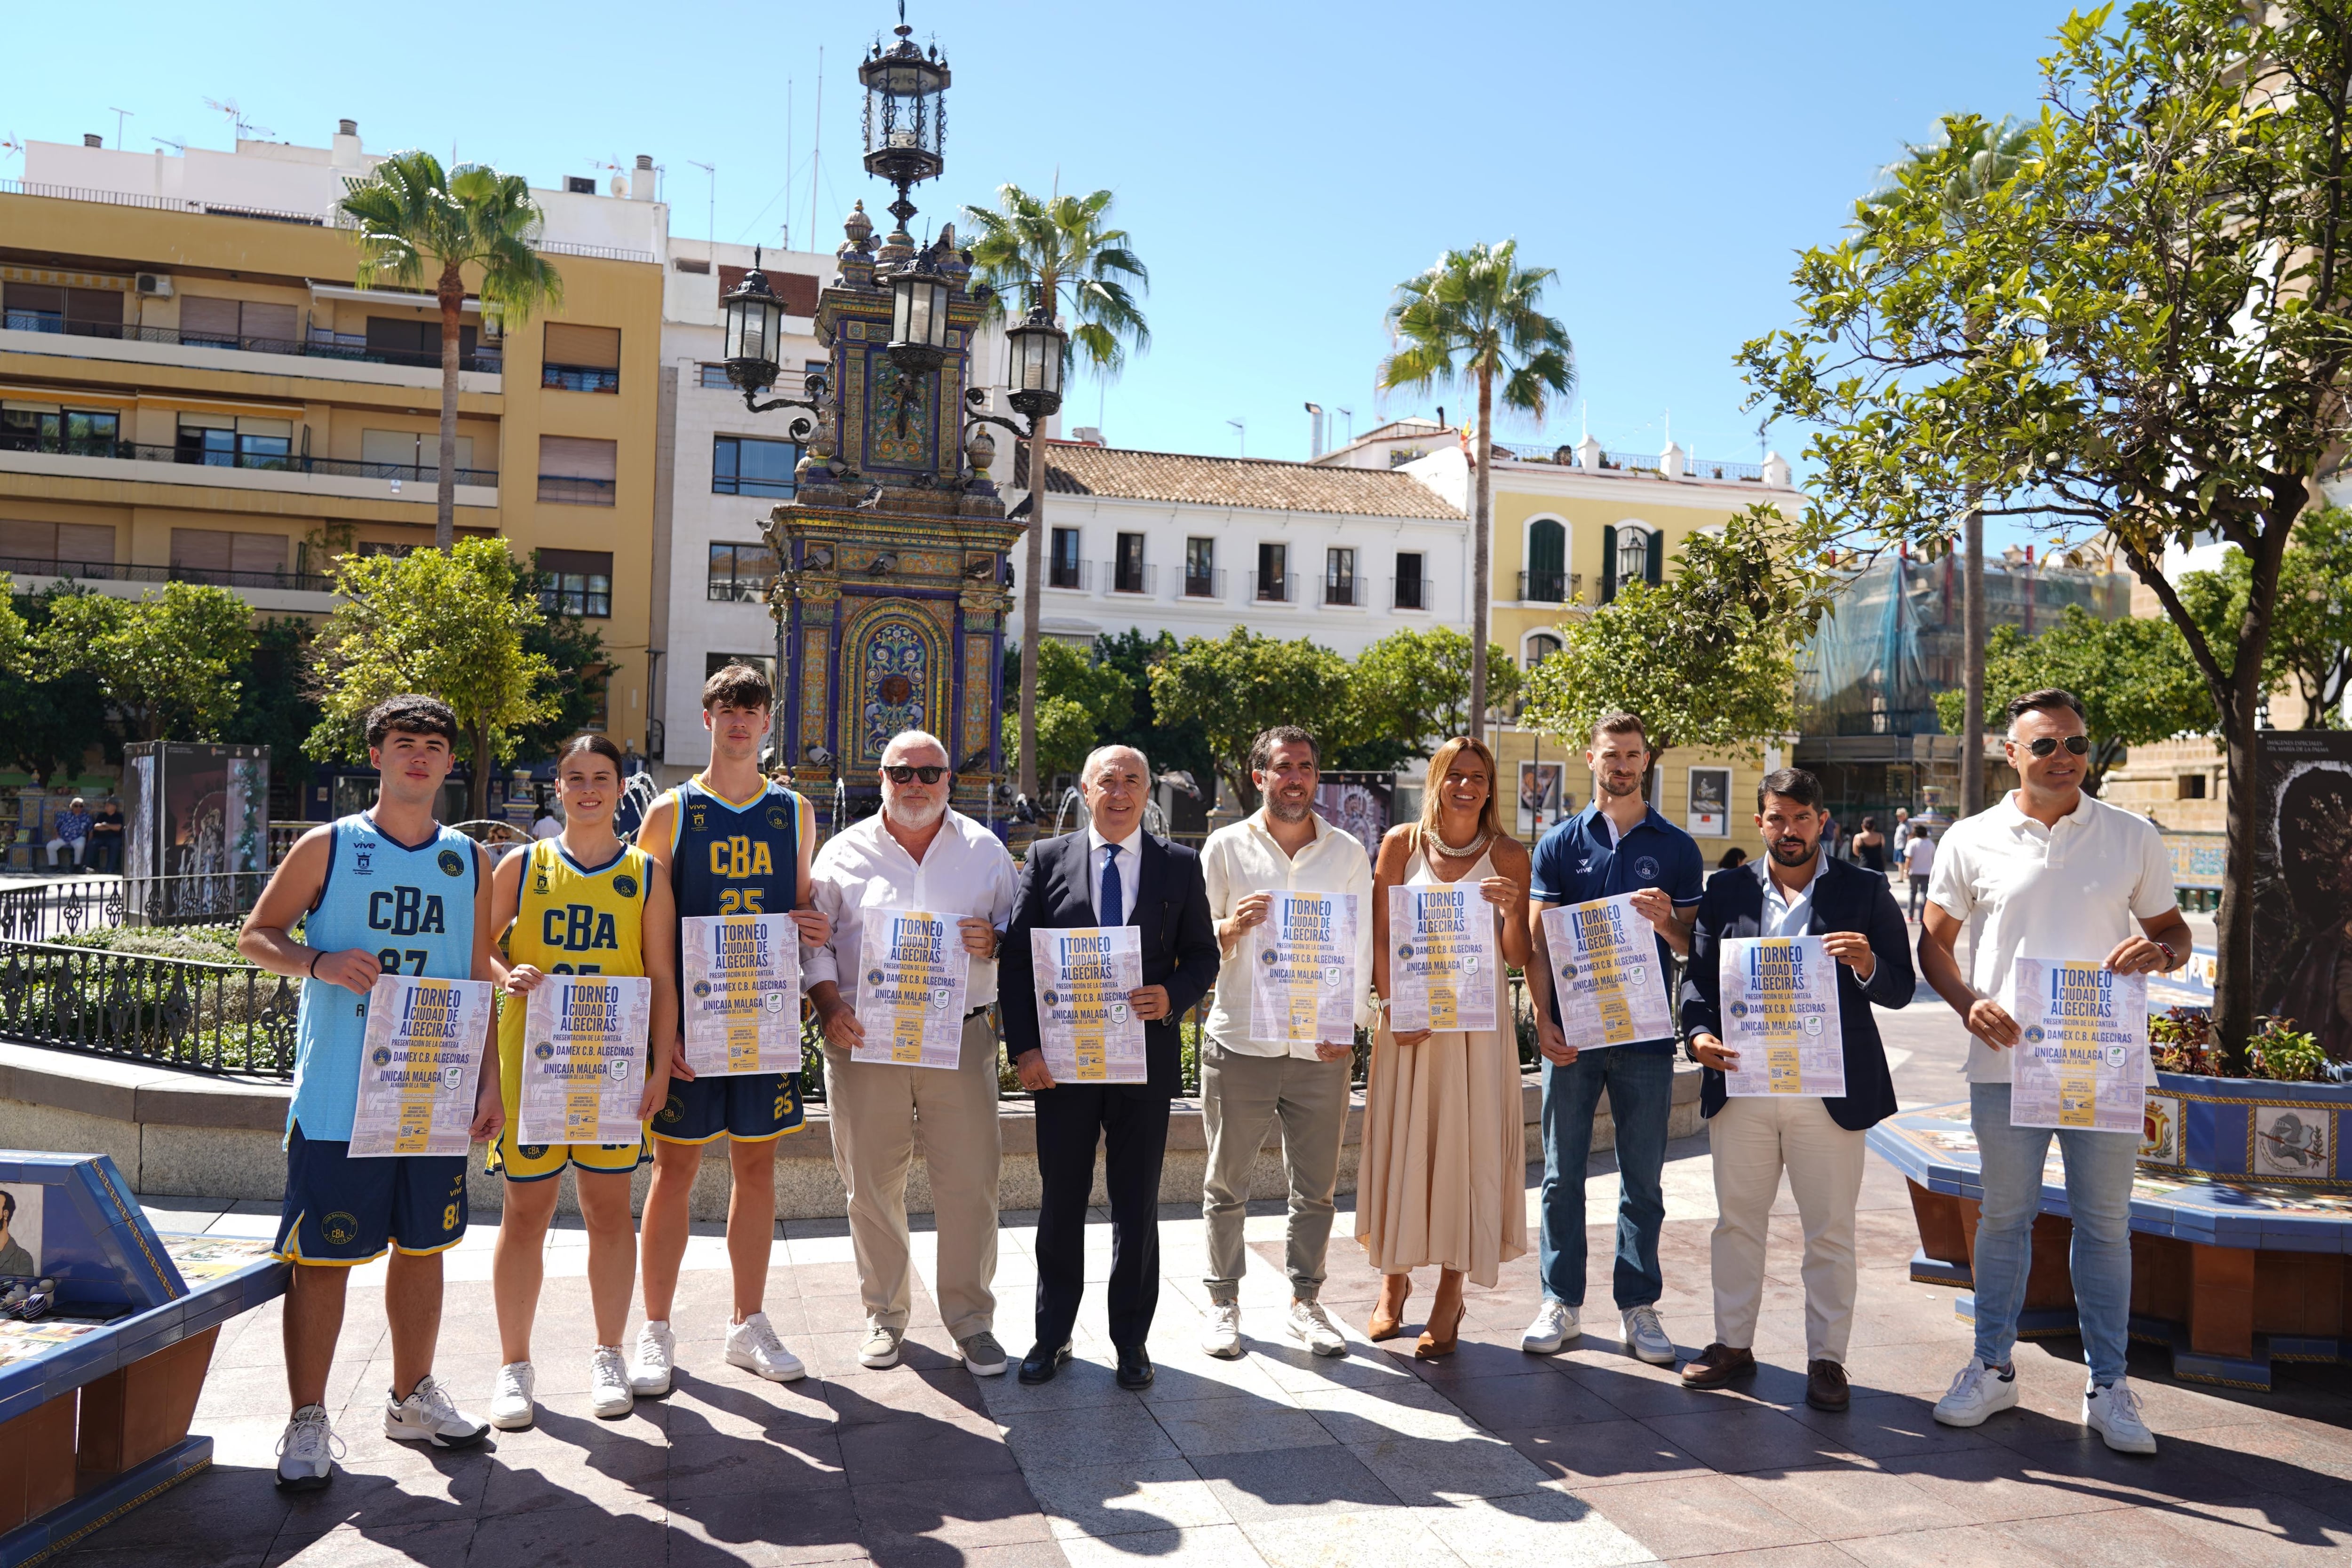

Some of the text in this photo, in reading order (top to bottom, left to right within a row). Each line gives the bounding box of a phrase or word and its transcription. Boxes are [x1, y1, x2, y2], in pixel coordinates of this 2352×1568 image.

[709, 835, 773, 879] CBA
[719, 888, 764, 915] 25
[1418, 891, 1464, 920] I TORNEO
[368, 886, 445, 935] CBA
[1284, 899, 1331, 926] I TORNEO
[1424, 908, 1464, 920] CIUDAD DE
[543, 904, 618, 951] CBA
[1290, 916, 1330, 928] CIUDAD DE
[1418, 919, 1464, 934] ALGECIRAS
[1572, 904, 1621, 939] I TORNEO
[892, 919, 943, 946] I TORNEO
[1283, 927, 1329, 942] ALGECIRAS
[1581, 920, 1623, 938] CIUDAD DE
[715, 923, 767, 954] I TORNEO
[898, 936, 942, 950] CIUDAD DE
[1578, 931, 1626, 952] ALGECIRAS
[723, 941, 767, 954] CIUDAD DE
[1060, 936, 1111, 966] I TORNEO
[1416, 946, 1435, 955] DAMEX
[1451, 944, 1482, 953] ALGECIRAS
[377, 948, 428, 976] 87
[715, 953, 768, 969] ALGECIRAS
[890, 947, 940, 963] ALGECIRAS
[1067, 953, 1111, 966] CIUDAD DE
[1280, 953, 1344, 965] DAMEX C.B. ALGECIRAS
[1751, 946, 1803, 975] I TORNEO
[1407, 962, 1432, 971] UNICAJA
[1579, 953, 1647, 973] DAMEX C.B. ALGECIRAS
[1757, 964, 1803, 976] CIUDAD DE
[1062, 966, 1112, 980] ALGECIRAS
[1270, 969, 1295, 979] UNICAJA
[714, 980, 787, 992] DAMEX C.B. ALGECIRAS
[887, 974, 955, 987] DAMEX C.B. ALGECIRAS
[1573, 978, 1599, 990] UNICAJA
[1751, 976, 1804, 990] ALGECIRAS
[2052, 969, 2112, 999] I TORNEO
[563, 985, 619, 1015] I TORNEO
[875, 989, 902, 1000] UNICAJA
[1061, 994, 1081, 1002] DAMEX
[1097, 991, 1131, 1002] ALGECIRAS
[2060, 988, 2112, 1002] CIUDAD DE
[403, 987, 461, 1019] I TORNEO
[704, 997, 763, 1010] UNICAJA MÁLAGA
[1750, 1004, 1826, 1013] DAMEX C.B. ALGECIRAS
[2051, 1001, 2111, 1017] ALGECIRAS
[410, 1007, 459, 1022] CIUDAD DE
[569, 1004, 617, 1017] CIUDAD DE
[1052, 1008, 1108, 1019] UNICAJA MÁLAGA
[399, 1021, 456, 1037] ALGECIRAS
[561, 1017, 616, 1031] ALGECIRAS
[1741, 1019, 1802, 1030] UNICAJA MÁLAGA
[2048, 1030, 2132, 1043] DAMEX C.B. ALGECIRAS
[394, 1052, 469, 1064] DAMEX C.B. ALGECIRAS
[556, 1046, 634, 1056] DAMEX C.B. ALGECIRAS
[2035, 1047, 2067, 1059] UNICAJA
[544, 1062, 607, 1074] UNICAJA MÁLAGA
[380, 1069, 441, 1082] UNICAJA MÁLAGA
[777, 1080, 790, 1089] vive
[774, 1089, 794, 1120] 25
[665, 1109, 674, 1117] CBA
[528, 1146, 540, 1155] CBA
[332, 1228, 345, 1238] CBA
